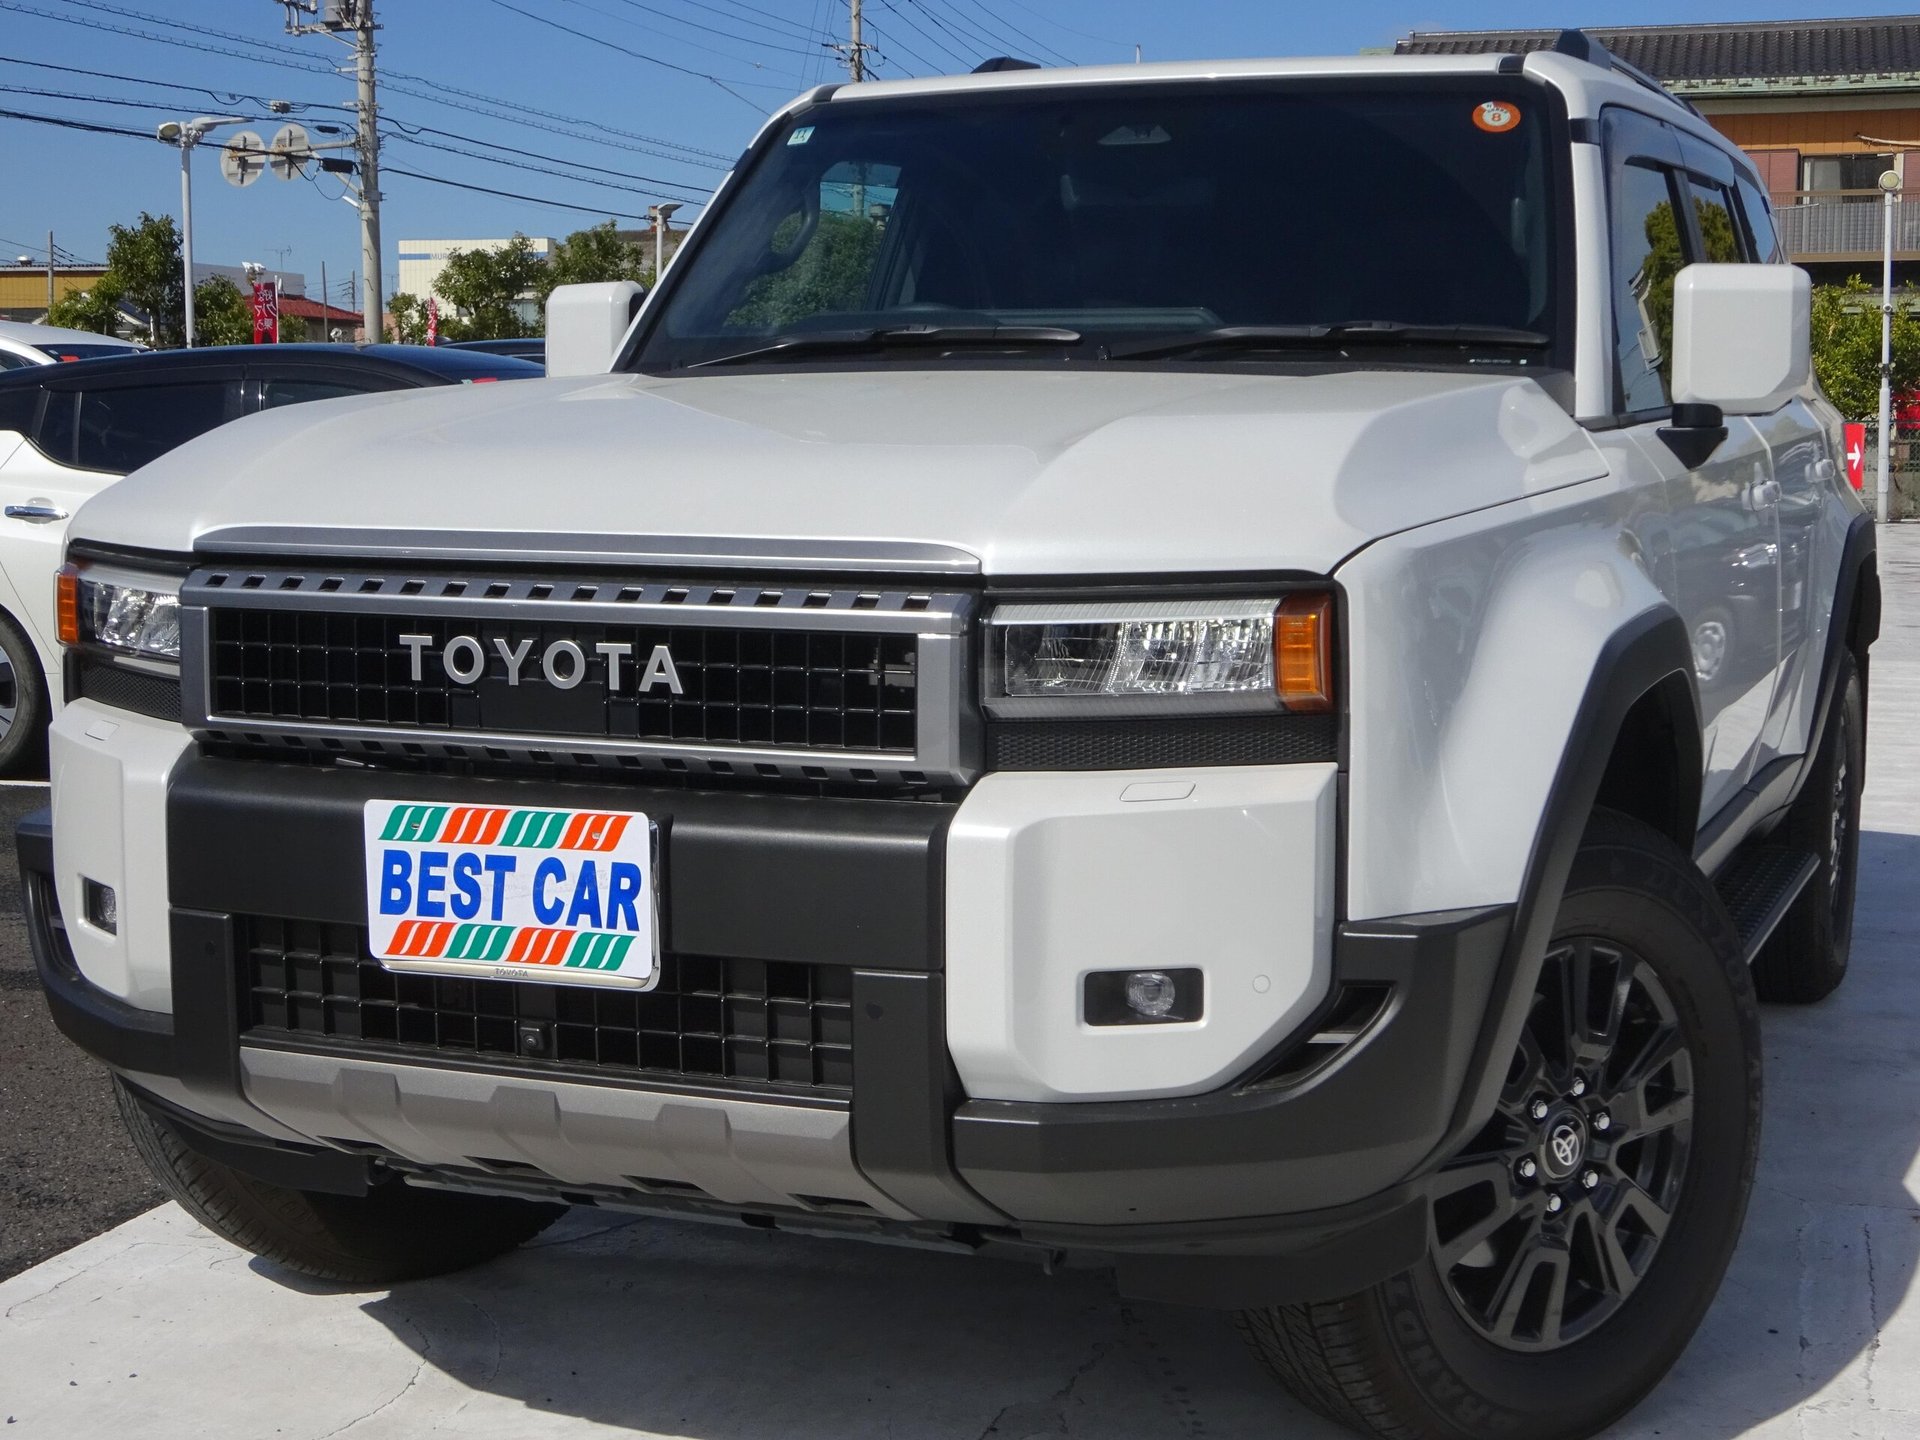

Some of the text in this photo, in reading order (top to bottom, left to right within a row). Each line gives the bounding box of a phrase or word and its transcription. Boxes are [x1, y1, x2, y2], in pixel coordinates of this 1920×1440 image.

[399, 634, 684, 695] TOYOTA
[379, 848, 643, 932] BEST CAR
[495, 967, 529, 977] TOYOTA
[1384, 1277, 1522, 1431] GRANDT
